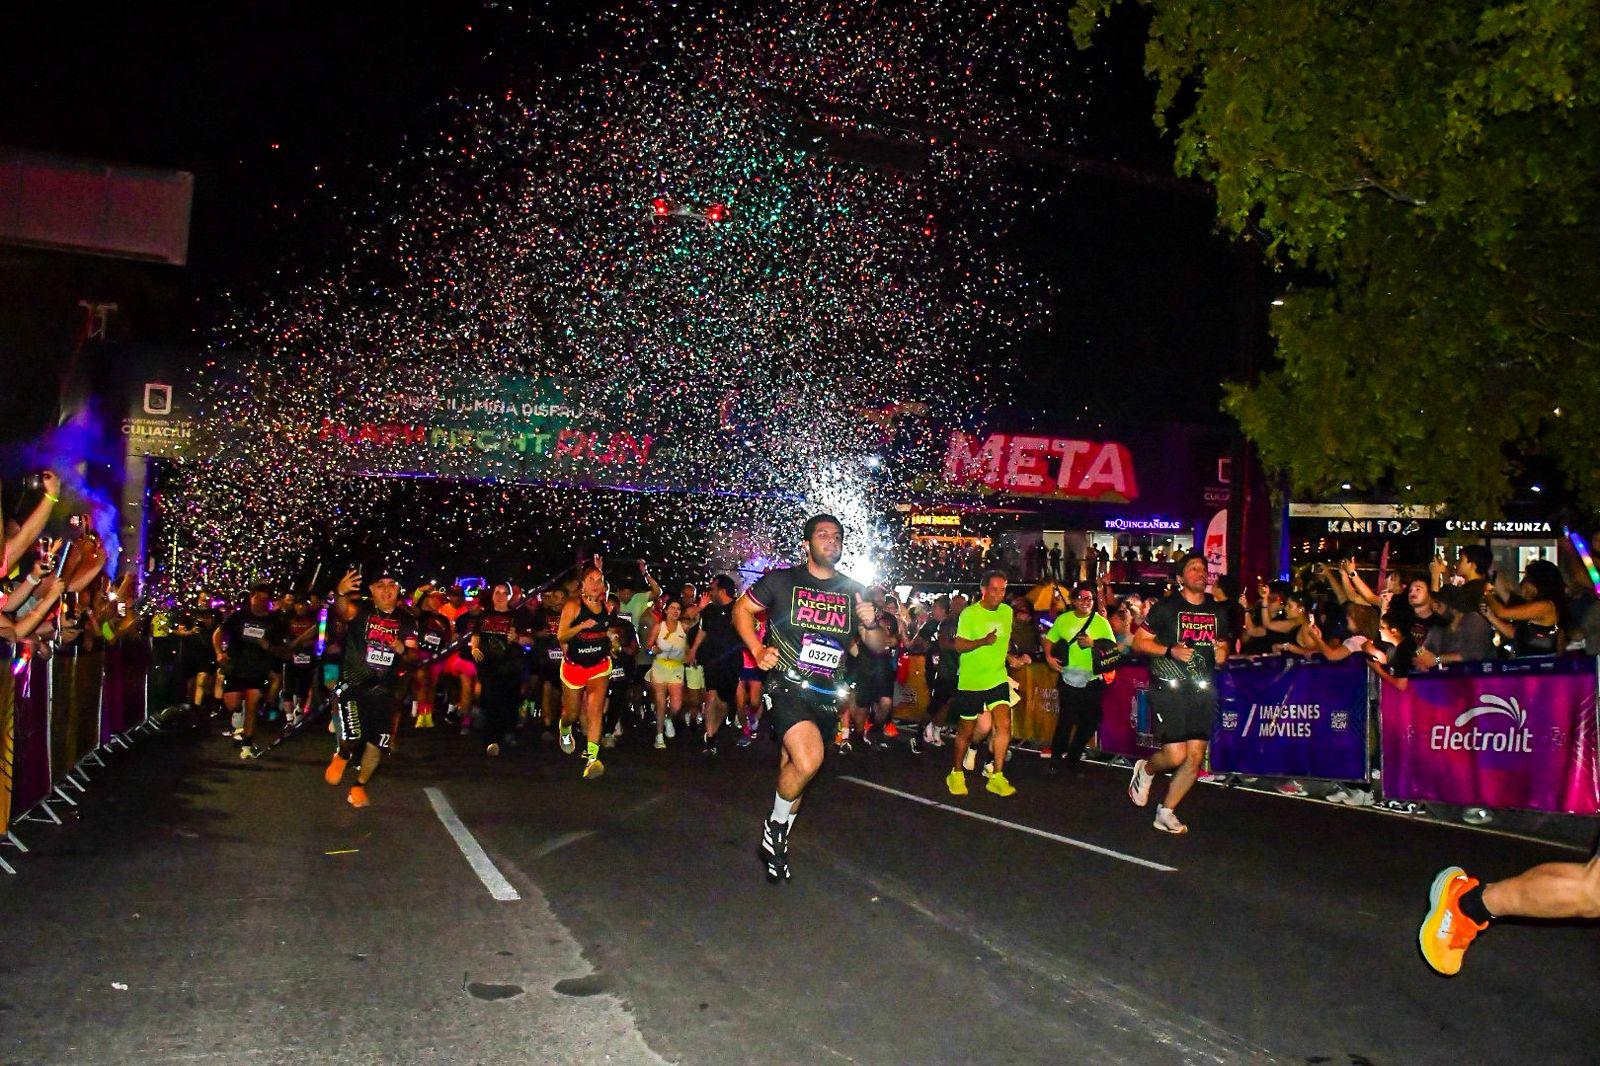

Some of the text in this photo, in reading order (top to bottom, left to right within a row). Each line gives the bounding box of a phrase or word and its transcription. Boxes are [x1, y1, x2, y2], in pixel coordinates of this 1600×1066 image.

[943, 431, 1127, 492] META
[798, 590, 846, 605] FLASH
[798, 598, 846, 613] NIGHT
[797, 606, 847, 628] RUN
[1181, 622, 1214, 631] NIGHT
[808, 649, 838, 664] 03276
[1430, 724, 1534, 753] Electrolit
